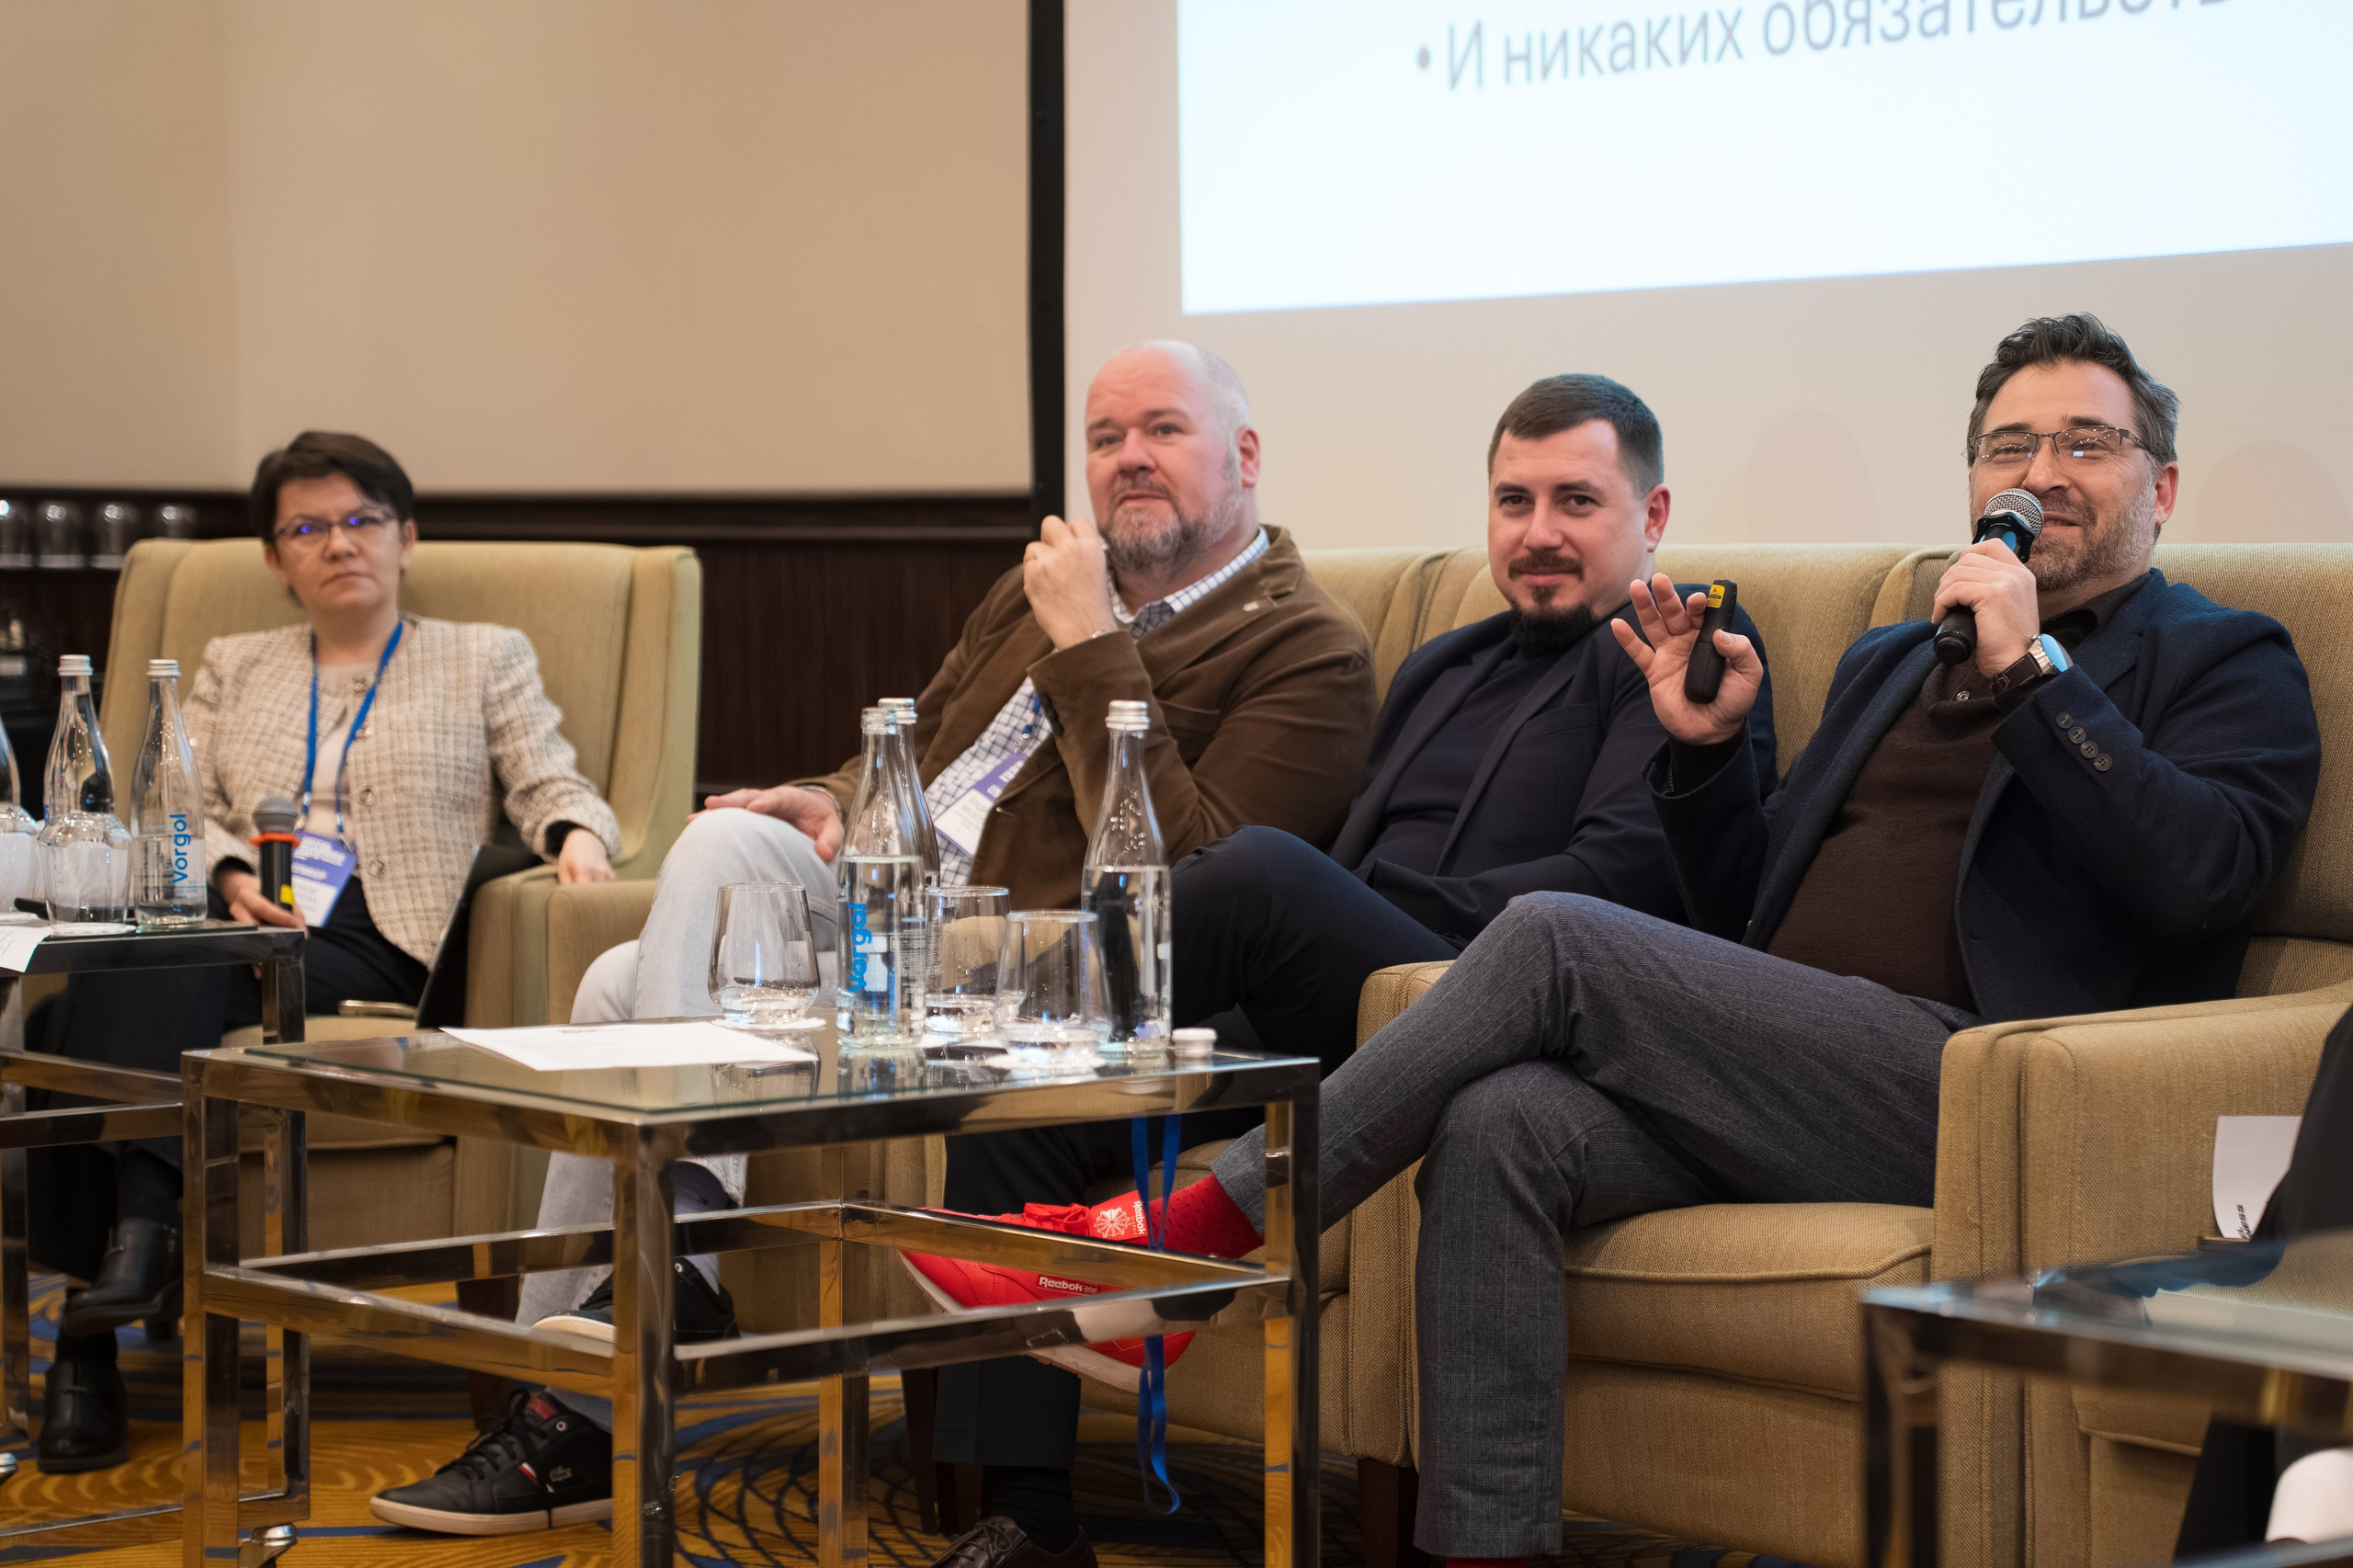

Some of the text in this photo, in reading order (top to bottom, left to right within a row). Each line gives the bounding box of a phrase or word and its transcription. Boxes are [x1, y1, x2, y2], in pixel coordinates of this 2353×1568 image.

[1448, 20, 1483, 91] И
[1504, 7, 1746, 85] никаких
[169, 813, 191, 883] Vorgol
[848, 903, 872, 993] Vorgol
[1132, 1200, 1146, 1235] Reebok
[1039, 1276, 1083, 1291] Reebok
